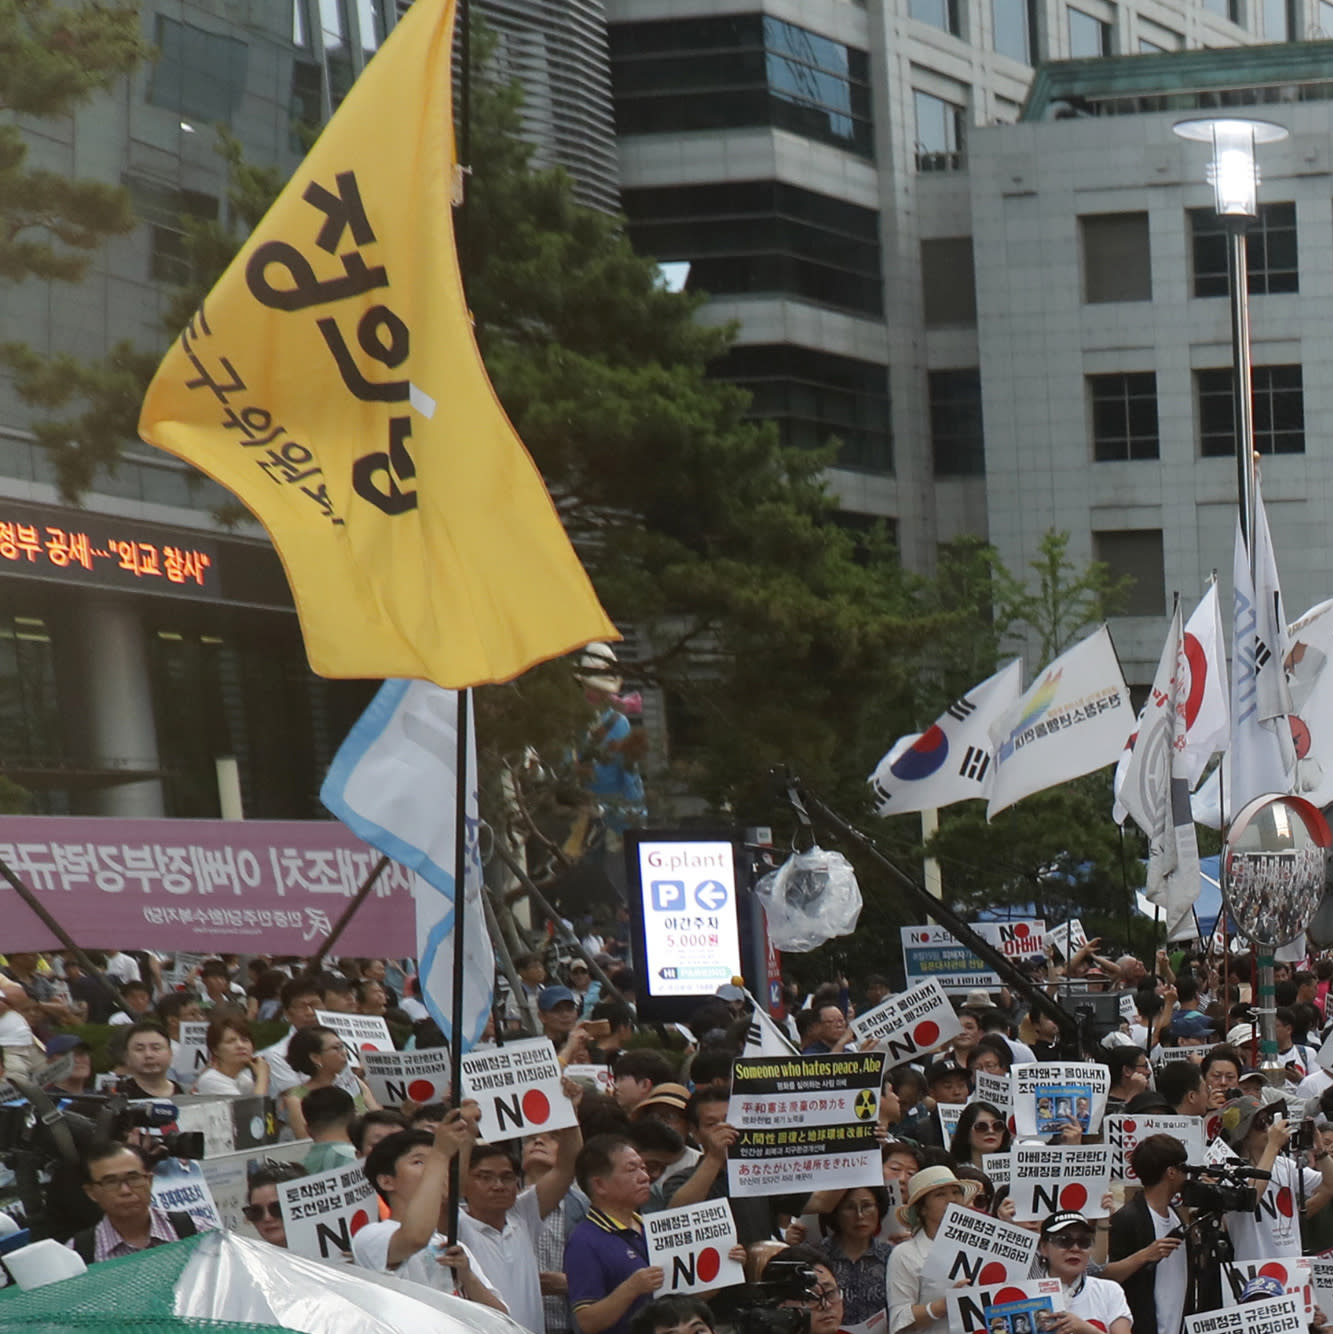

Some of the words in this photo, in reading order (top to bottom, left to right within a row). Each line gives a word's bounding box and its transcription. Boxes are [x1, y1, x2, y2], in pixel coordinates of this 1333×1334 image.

[648, 851, 725, 871] G.plant
[736, 1063, 780, 1080] Someone
[782, 1062, 800, 1077] who
[802, 1061, 831, 1076] hates
[863, 1058, 881, 1073] Abe
[1016, 1151, 1062, 1163] 아베정권
[1065, 1148, 1107, 1164] 규탄한다
[1016, 1165, 1062, 1179] 강제징용
[1065, 1163, 1107, 1178] 사죄하라
